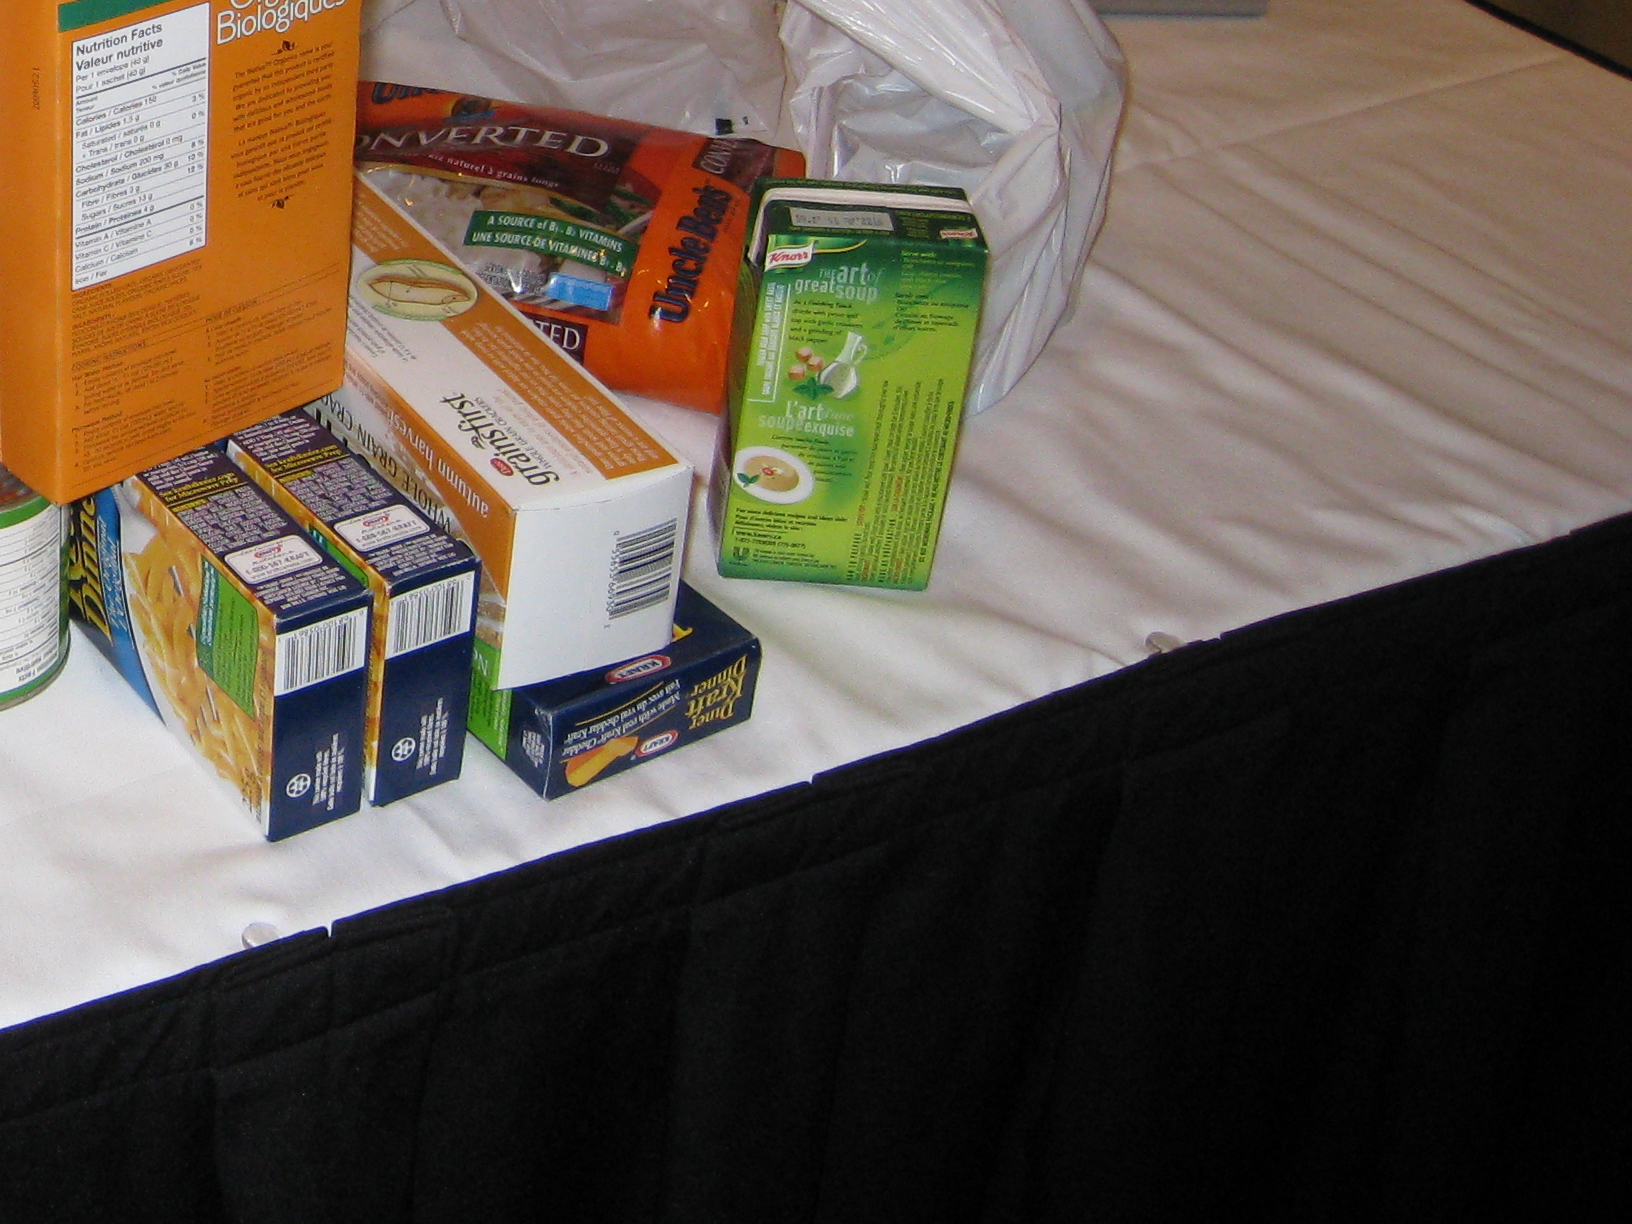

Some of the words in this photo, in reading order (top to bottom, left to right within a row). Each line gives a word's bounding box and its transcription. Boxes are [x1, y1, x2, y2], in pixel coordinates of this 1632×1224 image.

[76, 34, 128, 57] Nutrition
[131, 23, 163, 41] Facts
[76, 54, 114, 72] Valeur
[116, 38, 164, 61] nutritive
[357, 125, 609, 158] NVERTED
[447, 156, 485, 173] naturel
[497, 169, 528, 185] grains
[676, 184, 733, 243] Ben's
[472, 231, 492, 243] UNE
[494, 232, 532, 246] SOURCE
[533, 237, 547, 249] DE
[549, 240, 599, 261] VITAMINES
[498, 215, 535, 229] SOURCE
[537, 219, 546, 230] of
[579, 228, 623, 253] VITAMINS
[769, 250, 809, 263] Knorr
[838, 263, 868, 284] art
[648, 235, 712, 323] Uncle
[794, 278, 836, 294] great
[835, 284, 880, 303] soup
[320, 393, 353, 430] CRAC
[759, 414, 804, 432] soupe
[804, 422, 855, 437] exquise
[785, 400, 824, 420] L'art
[357, 422, 397, 478] GRAIN
[389, 409, 435, 472] harvest
[439, 391, 560, 486] grainsfirst
[403, 476, 451, 534] WHOLE
[436, 457, 490, 519] autumn
[80, 493, 114, 647] Dinne
[618, 659, 660, 679] KRAFT
[690, 653, 748, 697] Dinner
[685, 675, 746, 717] Kraft
[588, 714, 620, 734] cheddar
[622, 717, 638, 734] real
[638, 707, 658, 723] with
[561, 737, 597, 757] Cheddar
